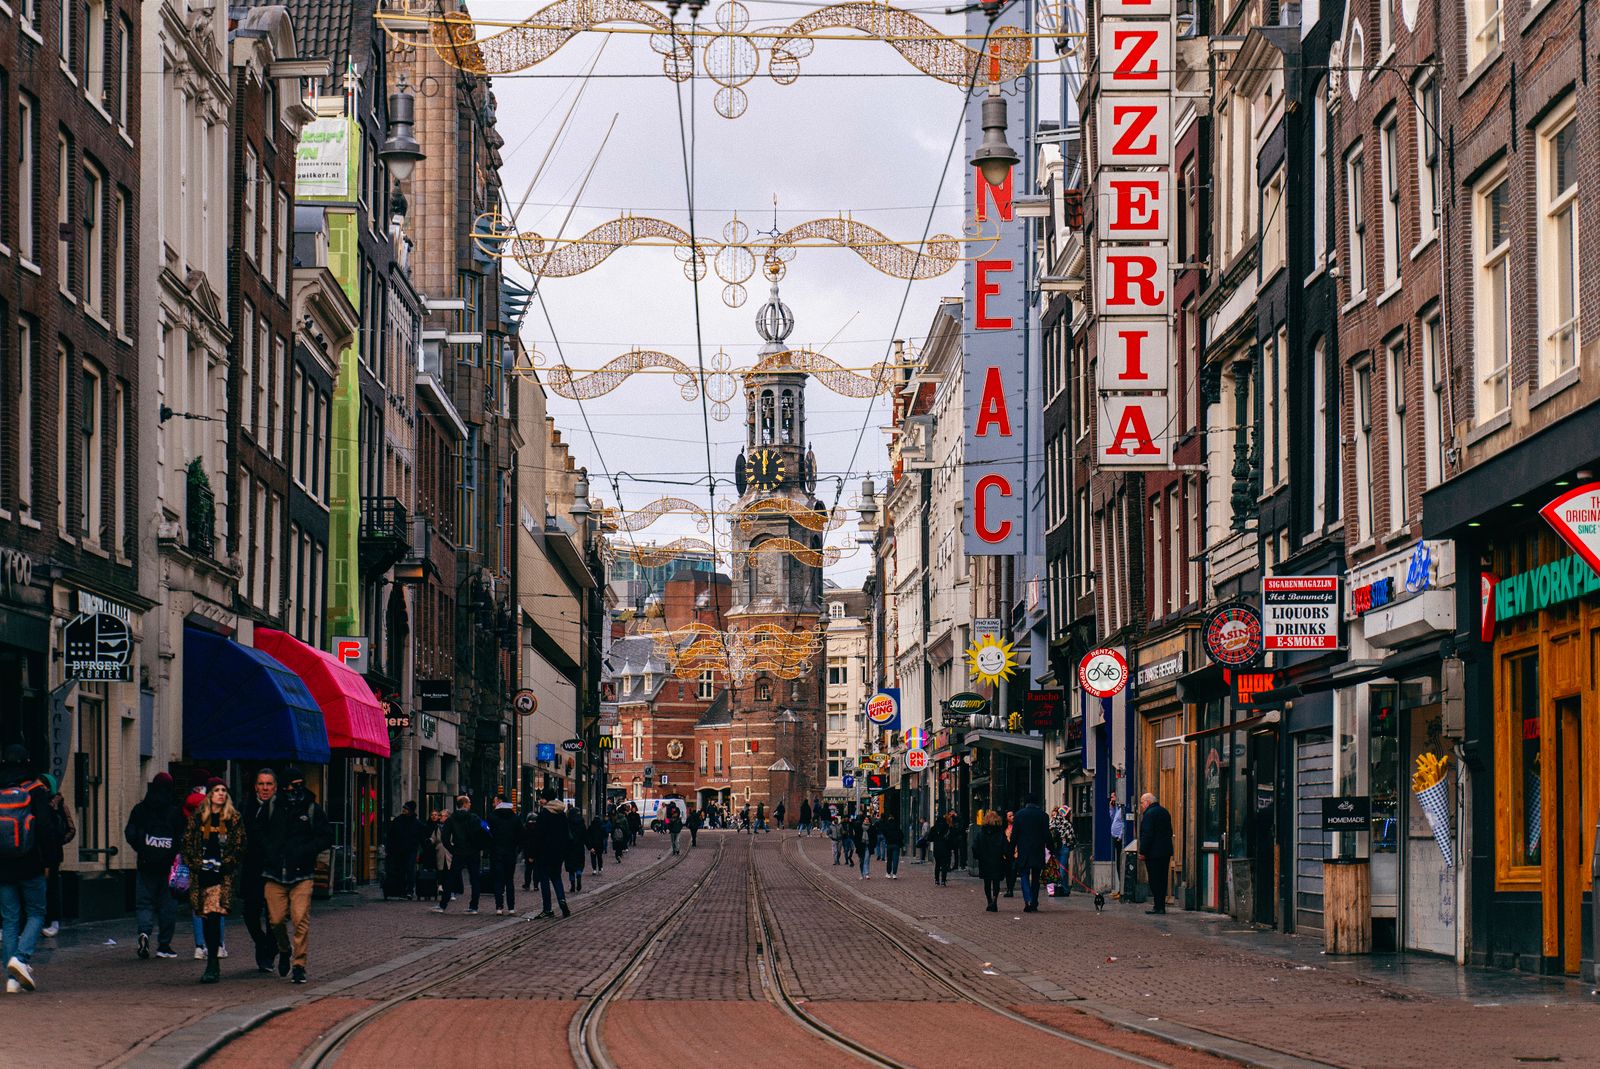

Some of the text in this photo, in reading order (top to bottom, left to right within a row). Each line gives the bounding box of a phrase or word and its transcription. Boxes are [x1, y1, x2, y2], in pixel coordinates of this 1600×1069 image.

[1106, 0, 1165, 455] ZZERIA
[975, 0, 1014, 544] INEAC
[1578, 525, 1596, 534] SINCE
[1268, 580, 1332, 589] SIGARENMAGAZIJN
[1495, 571, 1528, 622] NEW
[1530, 555, 1572, 609] YORK
[1272, 607, 1329, 620] LIQUORS
[1275, 623, 1326, 635] DRINKS
[1208, 625, 1260, 647] CASINO
[1277, 637, 1325, 647] E-SMOKE
[1091, 648, 1115, 657] RENTAL
[73, 661, 120, 670] BURGER
[1080, 666, 1101, 697] REPARATIE
[1112, 665, 1127, 694] VERKOOP
[1238, 673, 1275, 693] WOK
[868, 700, 892, 710] BURGER
[950, 700, 985, 708] SUBWAY
[869, 705, 893, 717] KING
[145, 833, 172, 848] VANS
